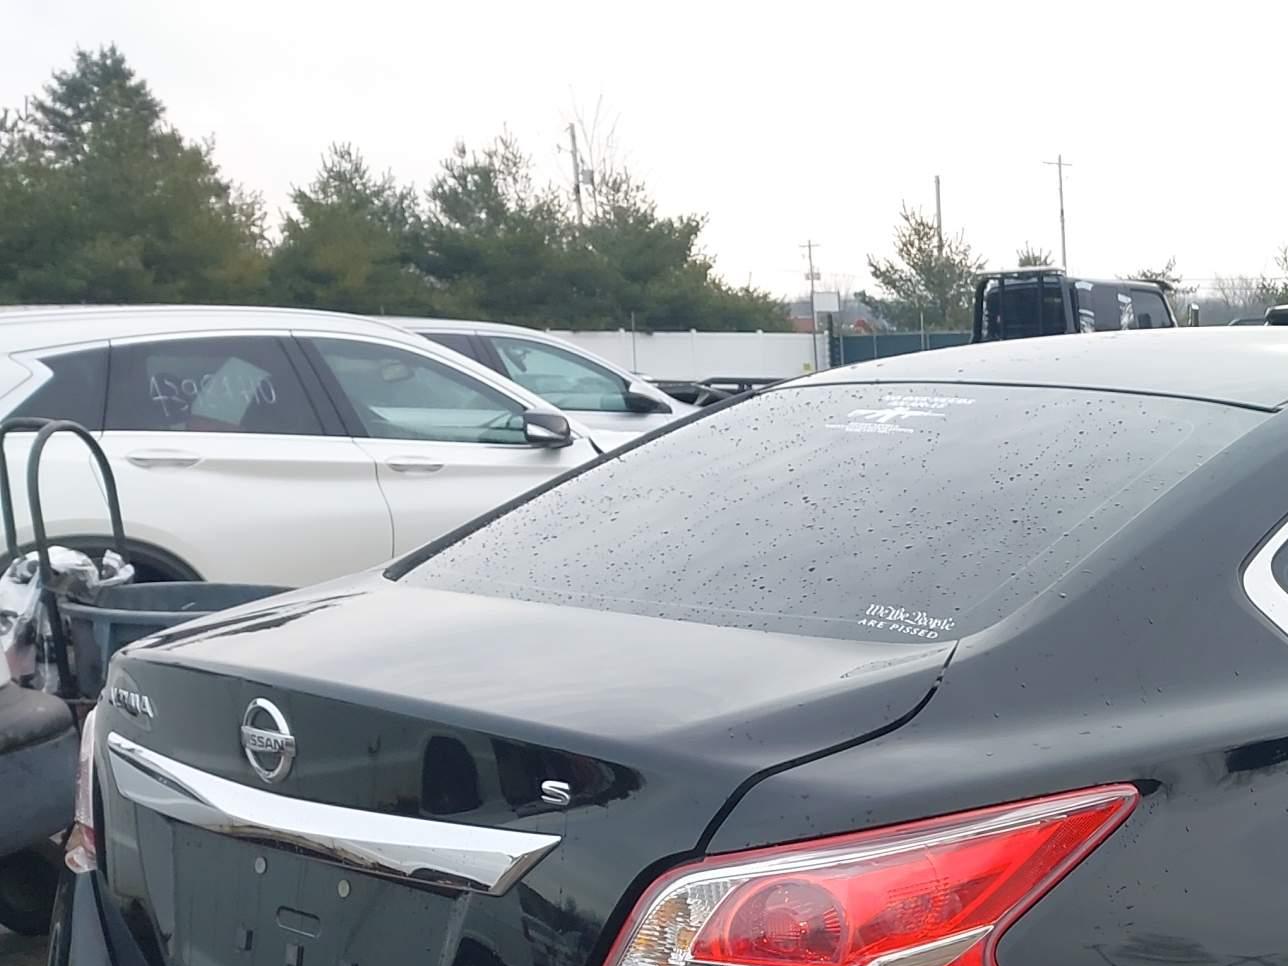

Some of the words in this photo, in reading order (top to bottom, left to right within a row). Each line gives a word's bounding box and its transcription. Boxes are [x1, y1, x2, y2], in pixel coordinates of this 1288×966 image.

[857, 618, 887, 628] ARE
[889, 623, 939, 639] PISSED
[244, 731, 286, 752] SSAN
[541, 780, 570, 805] S
